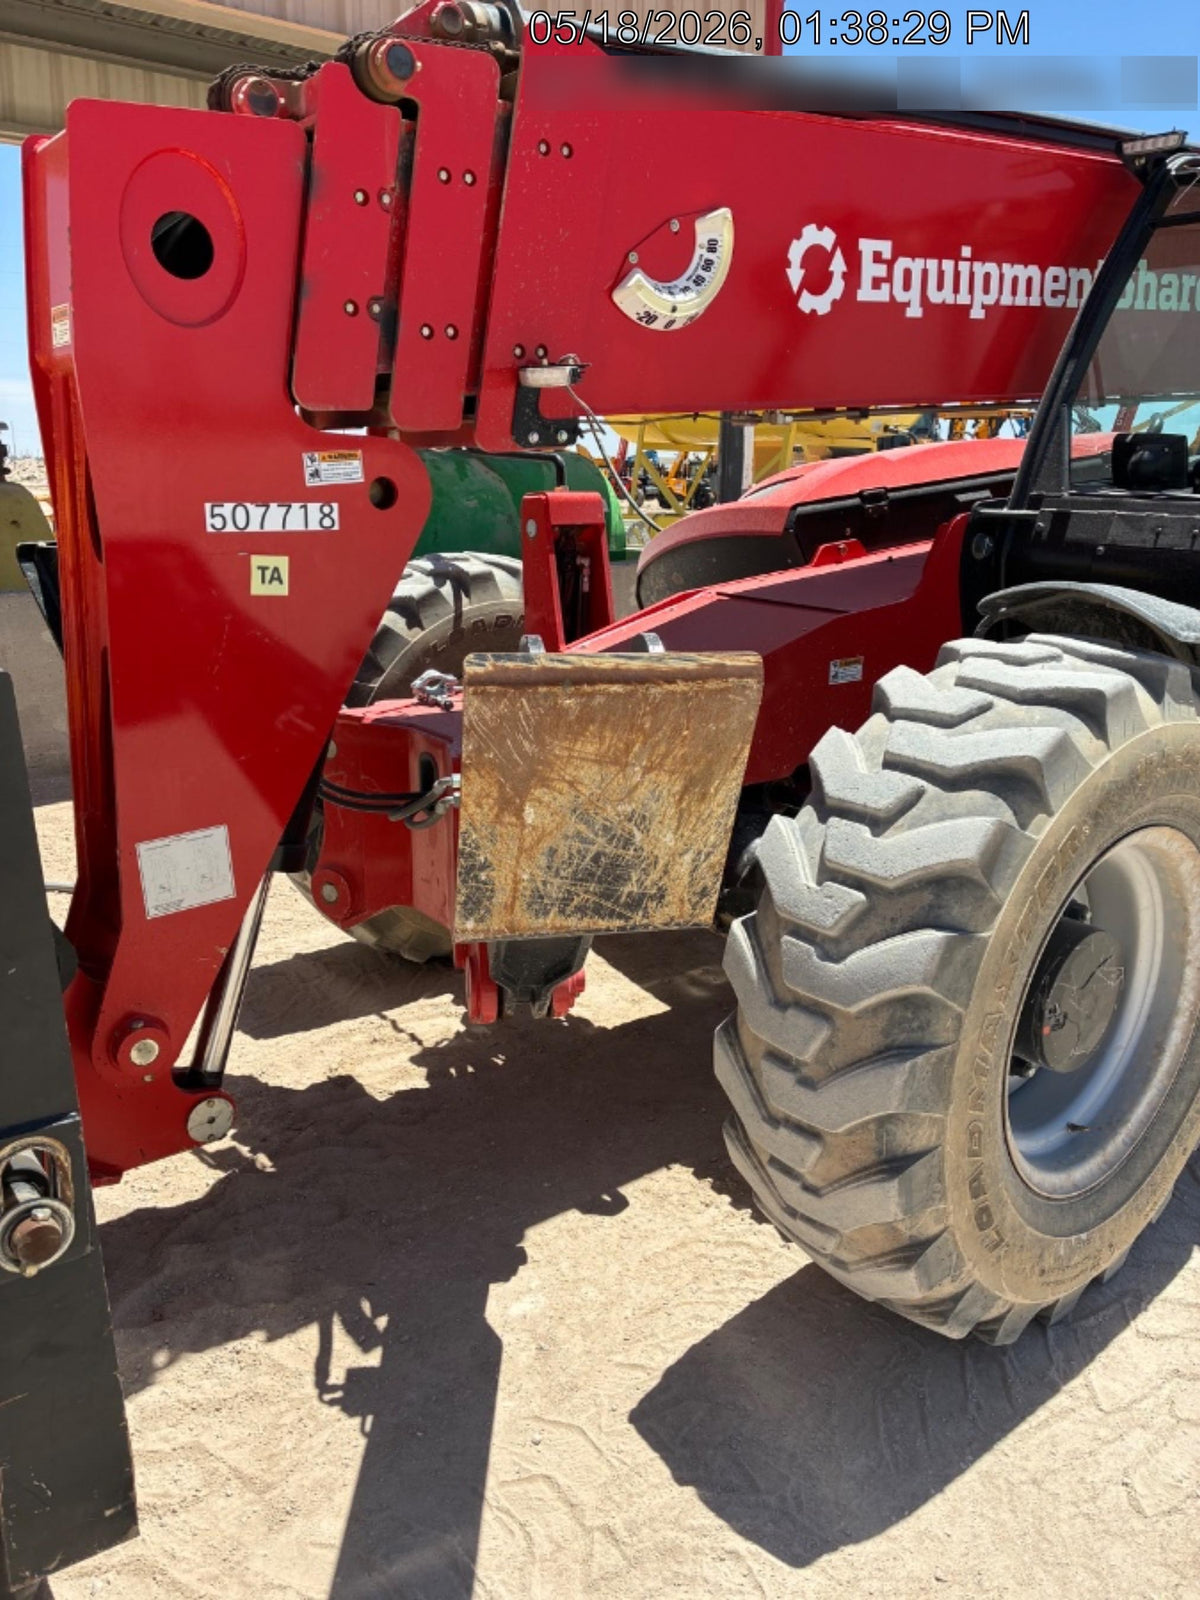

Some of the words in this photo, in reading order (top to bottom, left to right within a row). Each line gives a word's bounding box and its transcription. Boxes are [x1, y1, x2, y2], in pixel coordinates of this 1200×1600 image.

[707, 238, 719, 253] 80
[210, 503, 336, 531] 507718
[256, 565, 284, 585] TA
